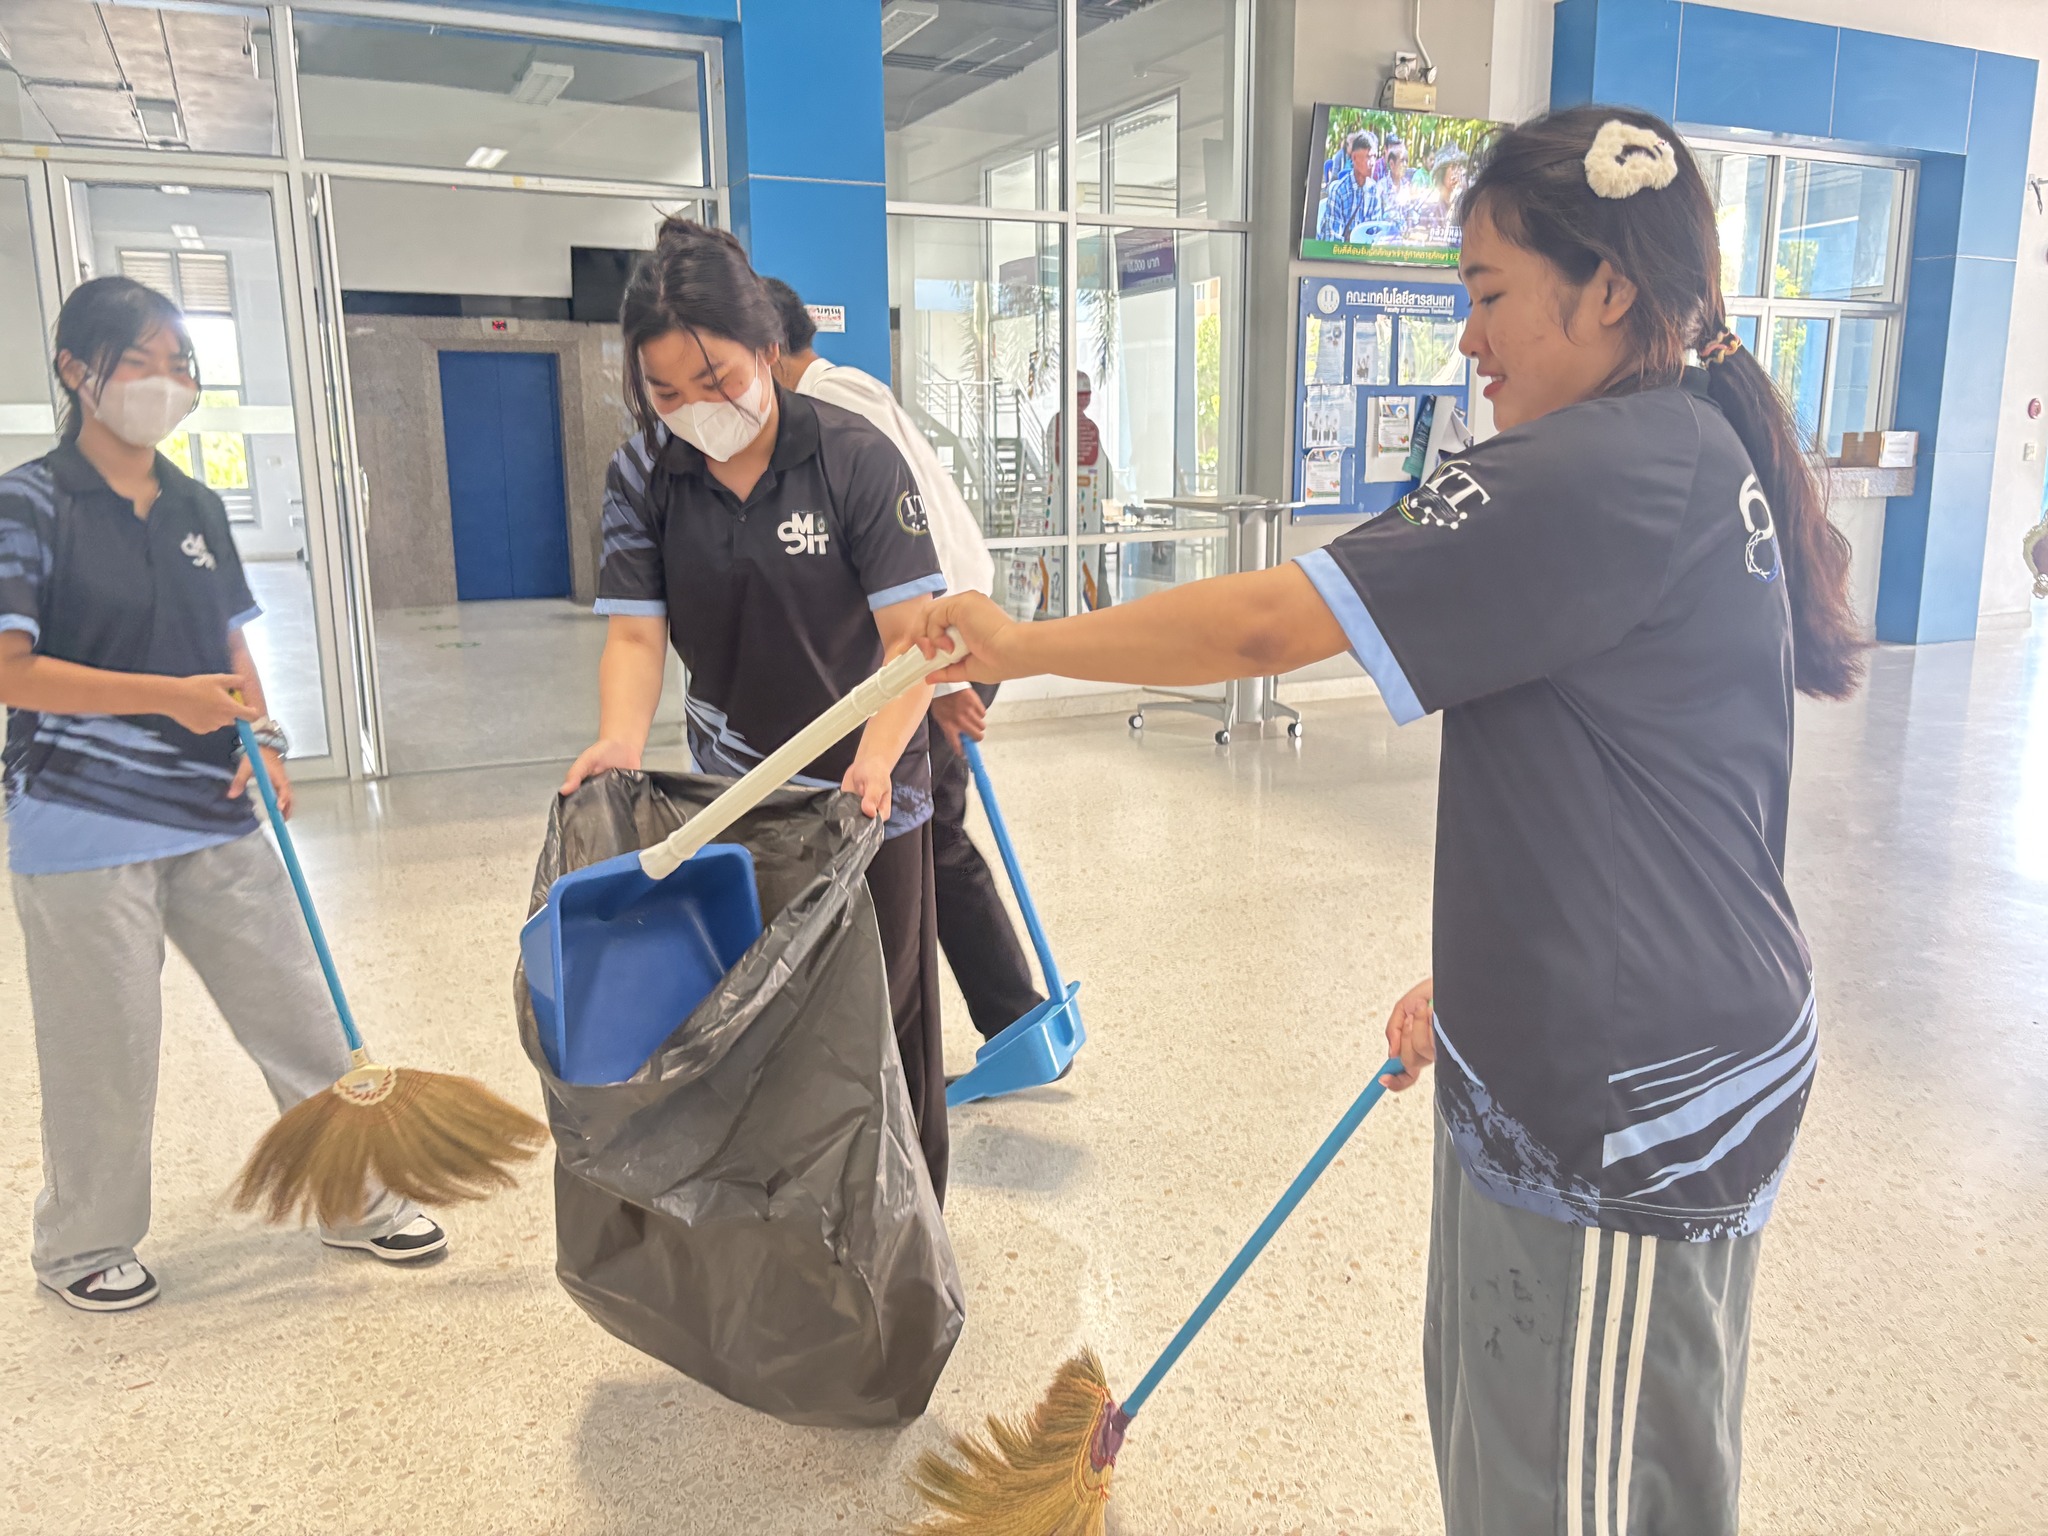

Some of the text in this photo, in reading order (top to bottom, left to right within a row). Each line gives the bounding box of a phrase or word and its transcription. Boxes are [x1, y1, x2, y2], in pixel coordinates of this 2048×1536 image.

[1346, 287, 1455, 307] คณะเทคโนโลยีสารสนเทศ
